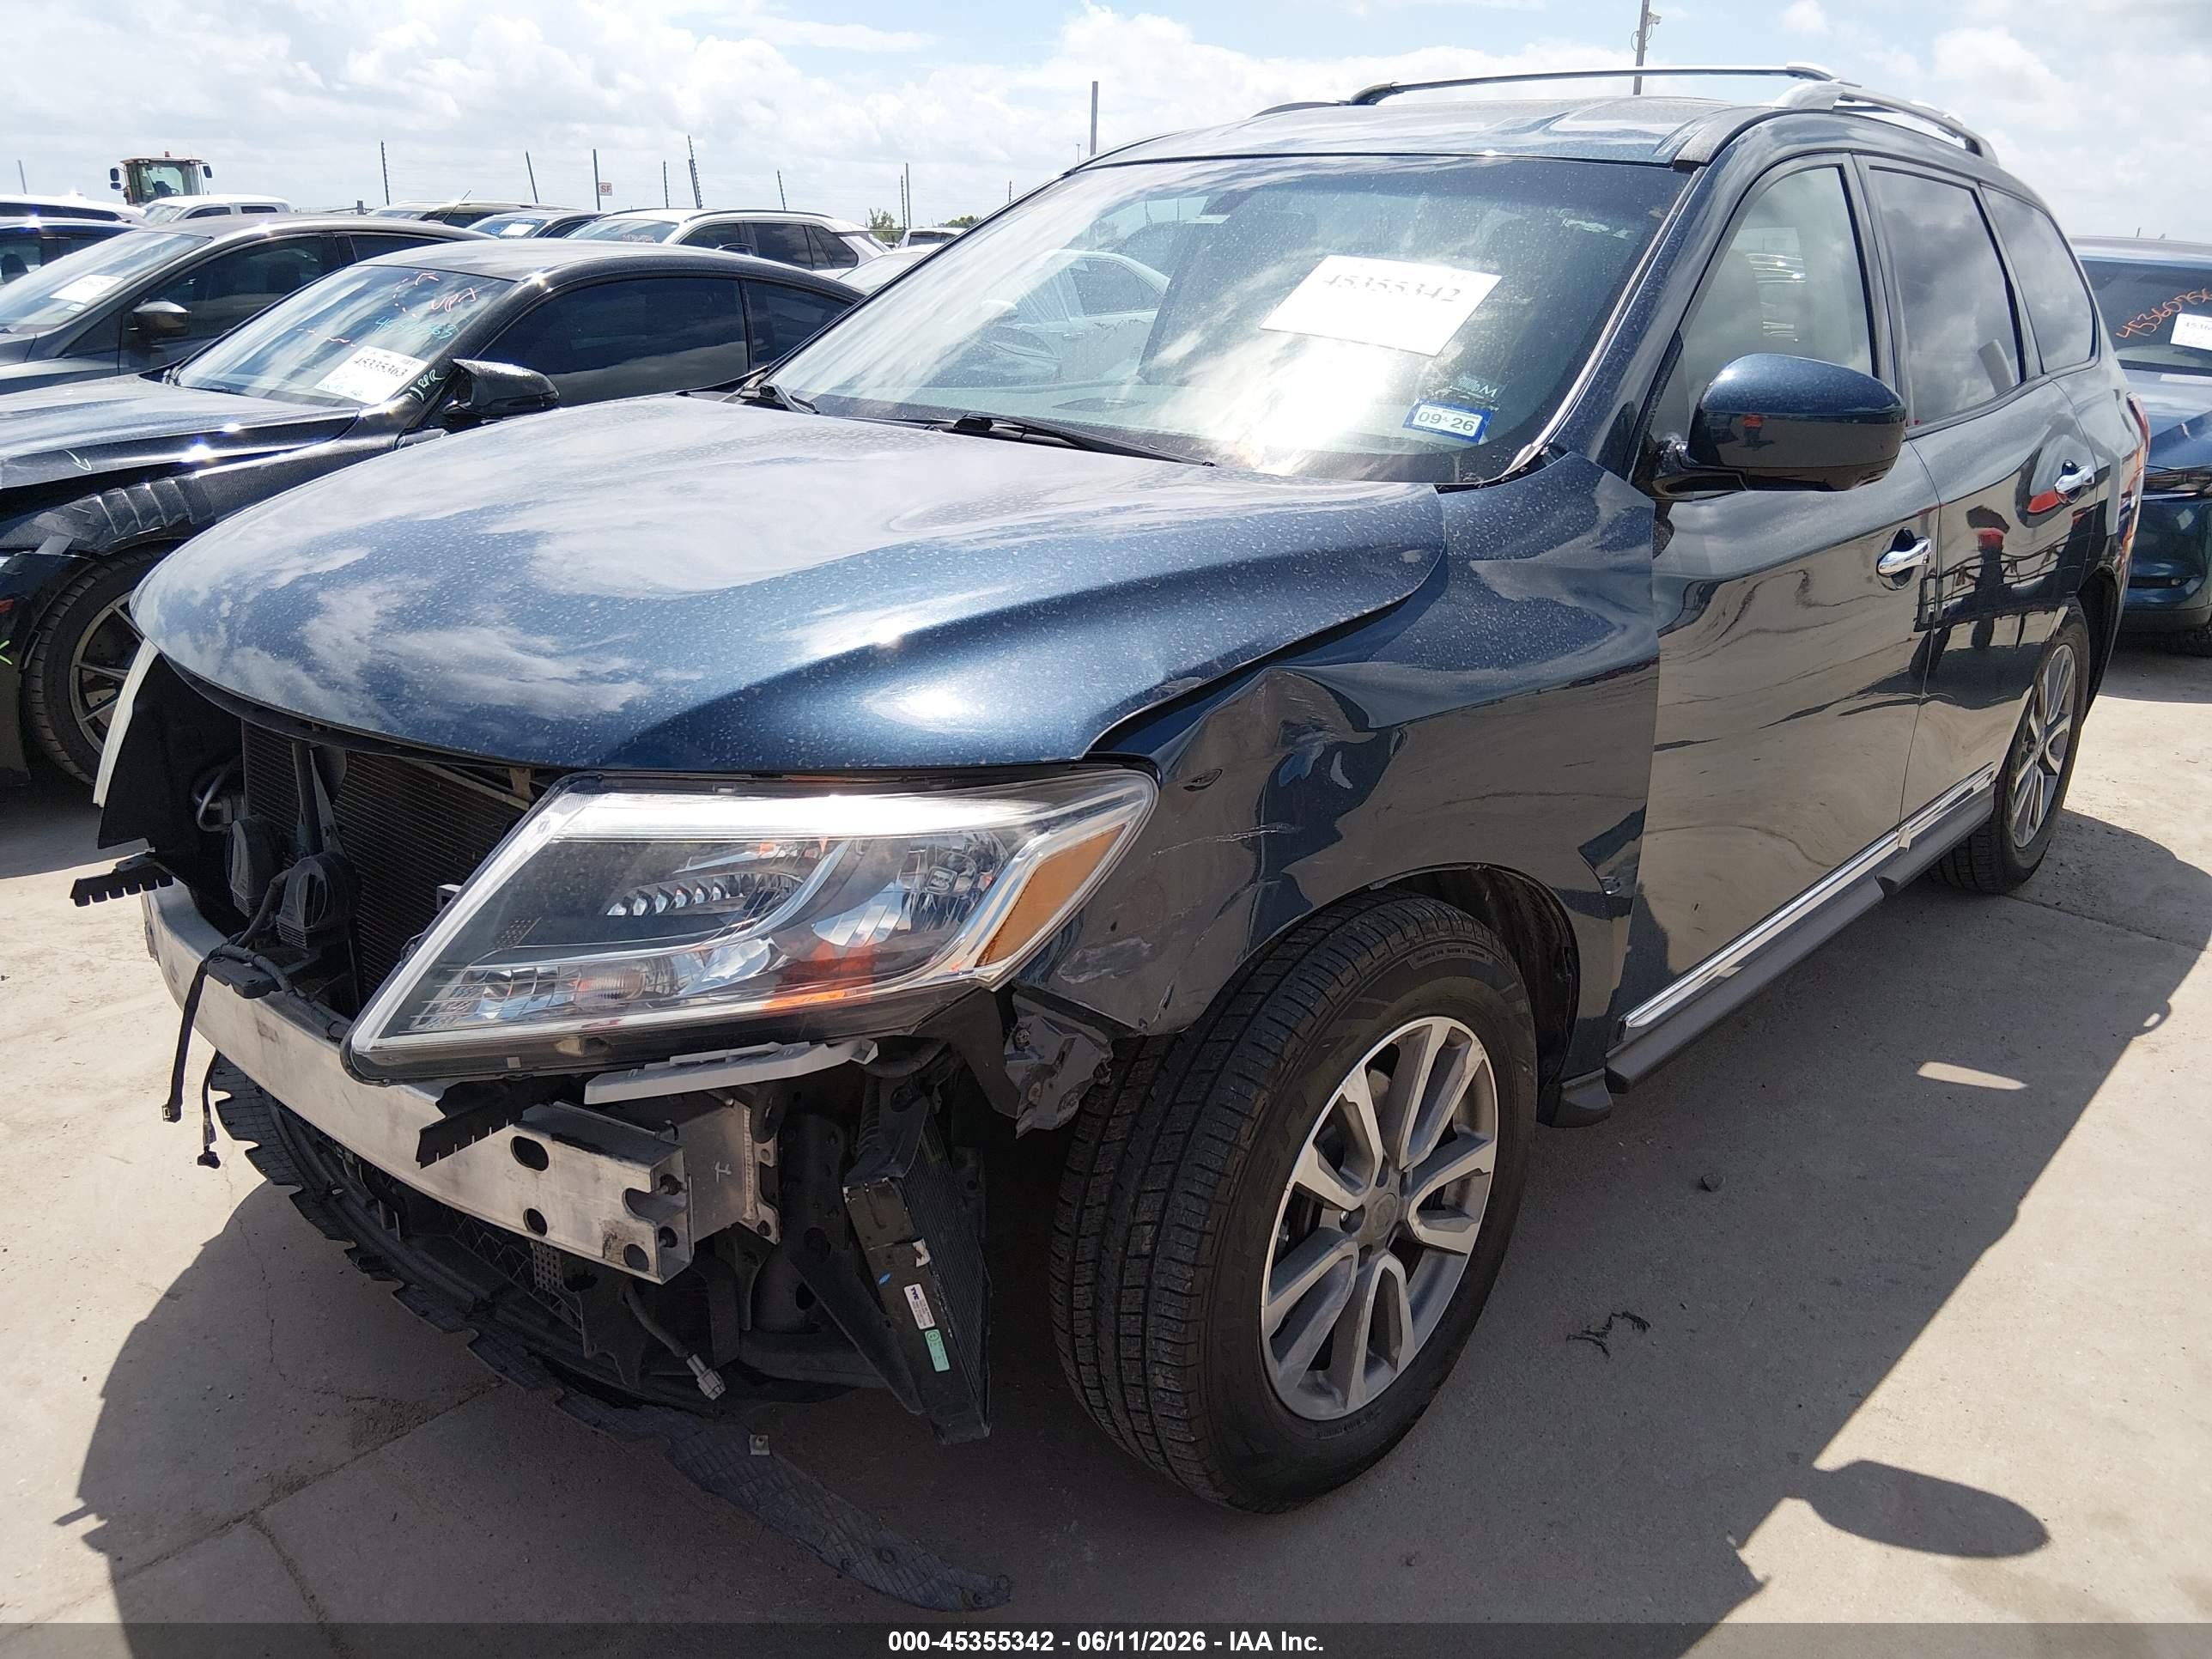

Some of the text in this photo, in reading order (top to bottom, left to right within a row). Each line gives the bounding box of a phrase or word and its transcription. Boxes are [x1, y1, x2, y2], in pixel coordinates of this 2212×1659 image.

[1323, 274, 1461, 302] 45355342
[1418, 411, 1443, 424] 09
[1449, 417, 1475, 432] 26
